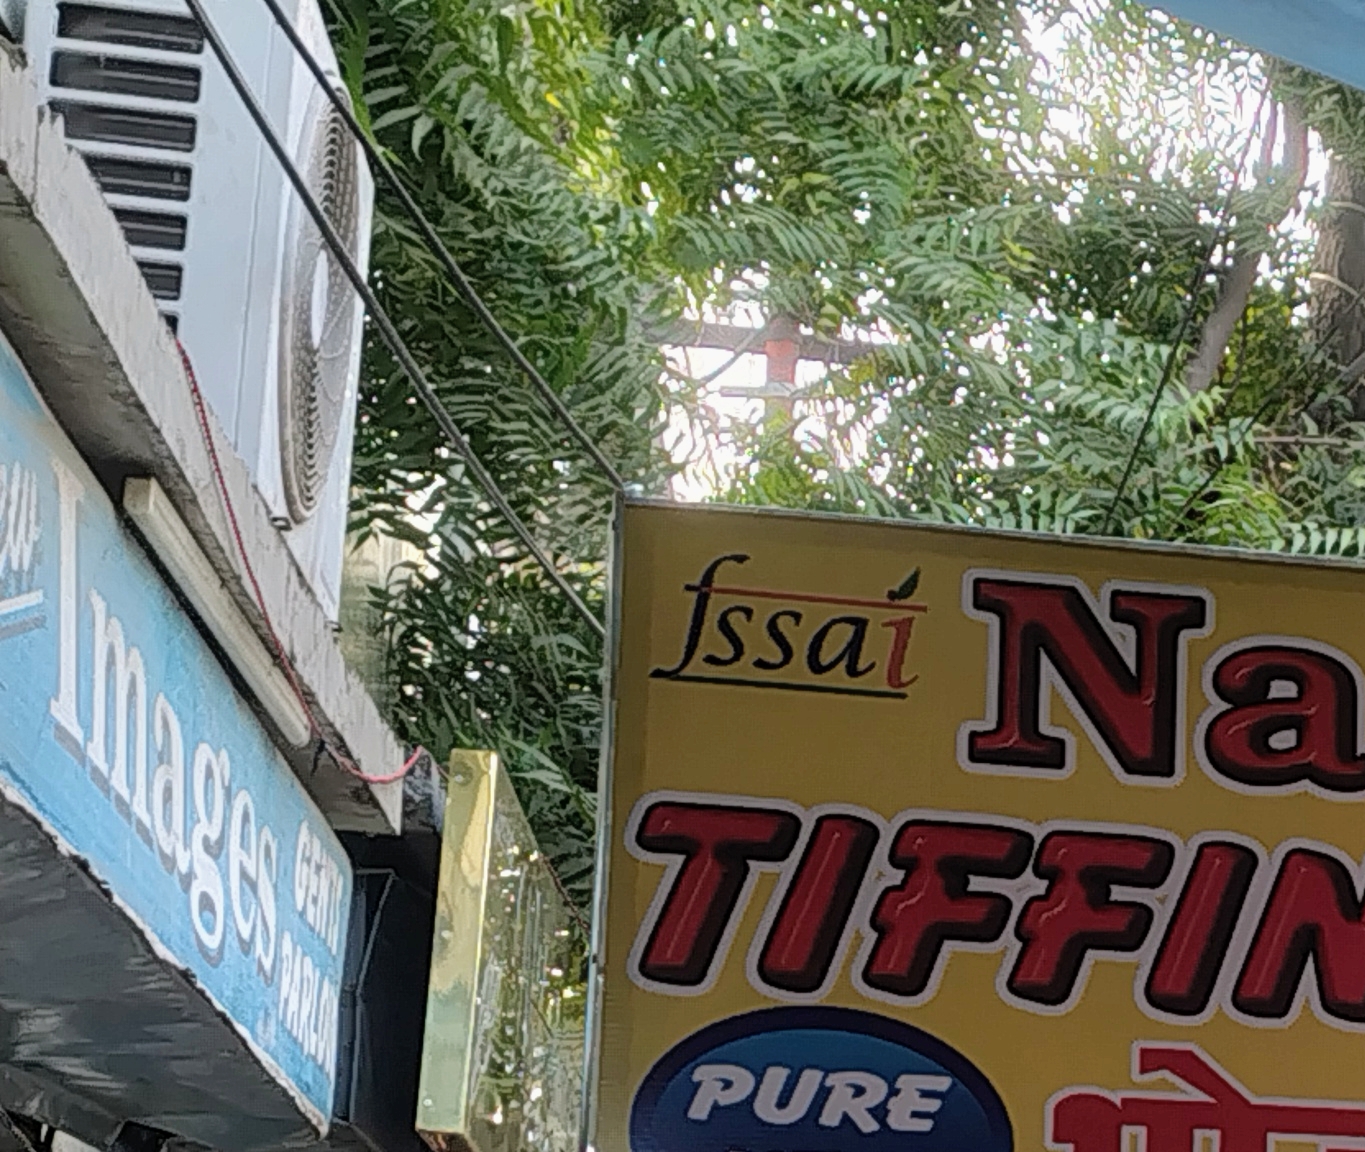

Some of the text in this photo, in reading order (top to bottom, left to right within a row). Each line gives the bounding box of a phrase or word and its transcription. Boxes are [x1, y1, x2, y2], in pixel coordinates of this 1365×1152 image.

[650, 554, 928, 698] fssai
[50, 458, 280, 976] Images
[687, 1062, 953, 1134] PURE
